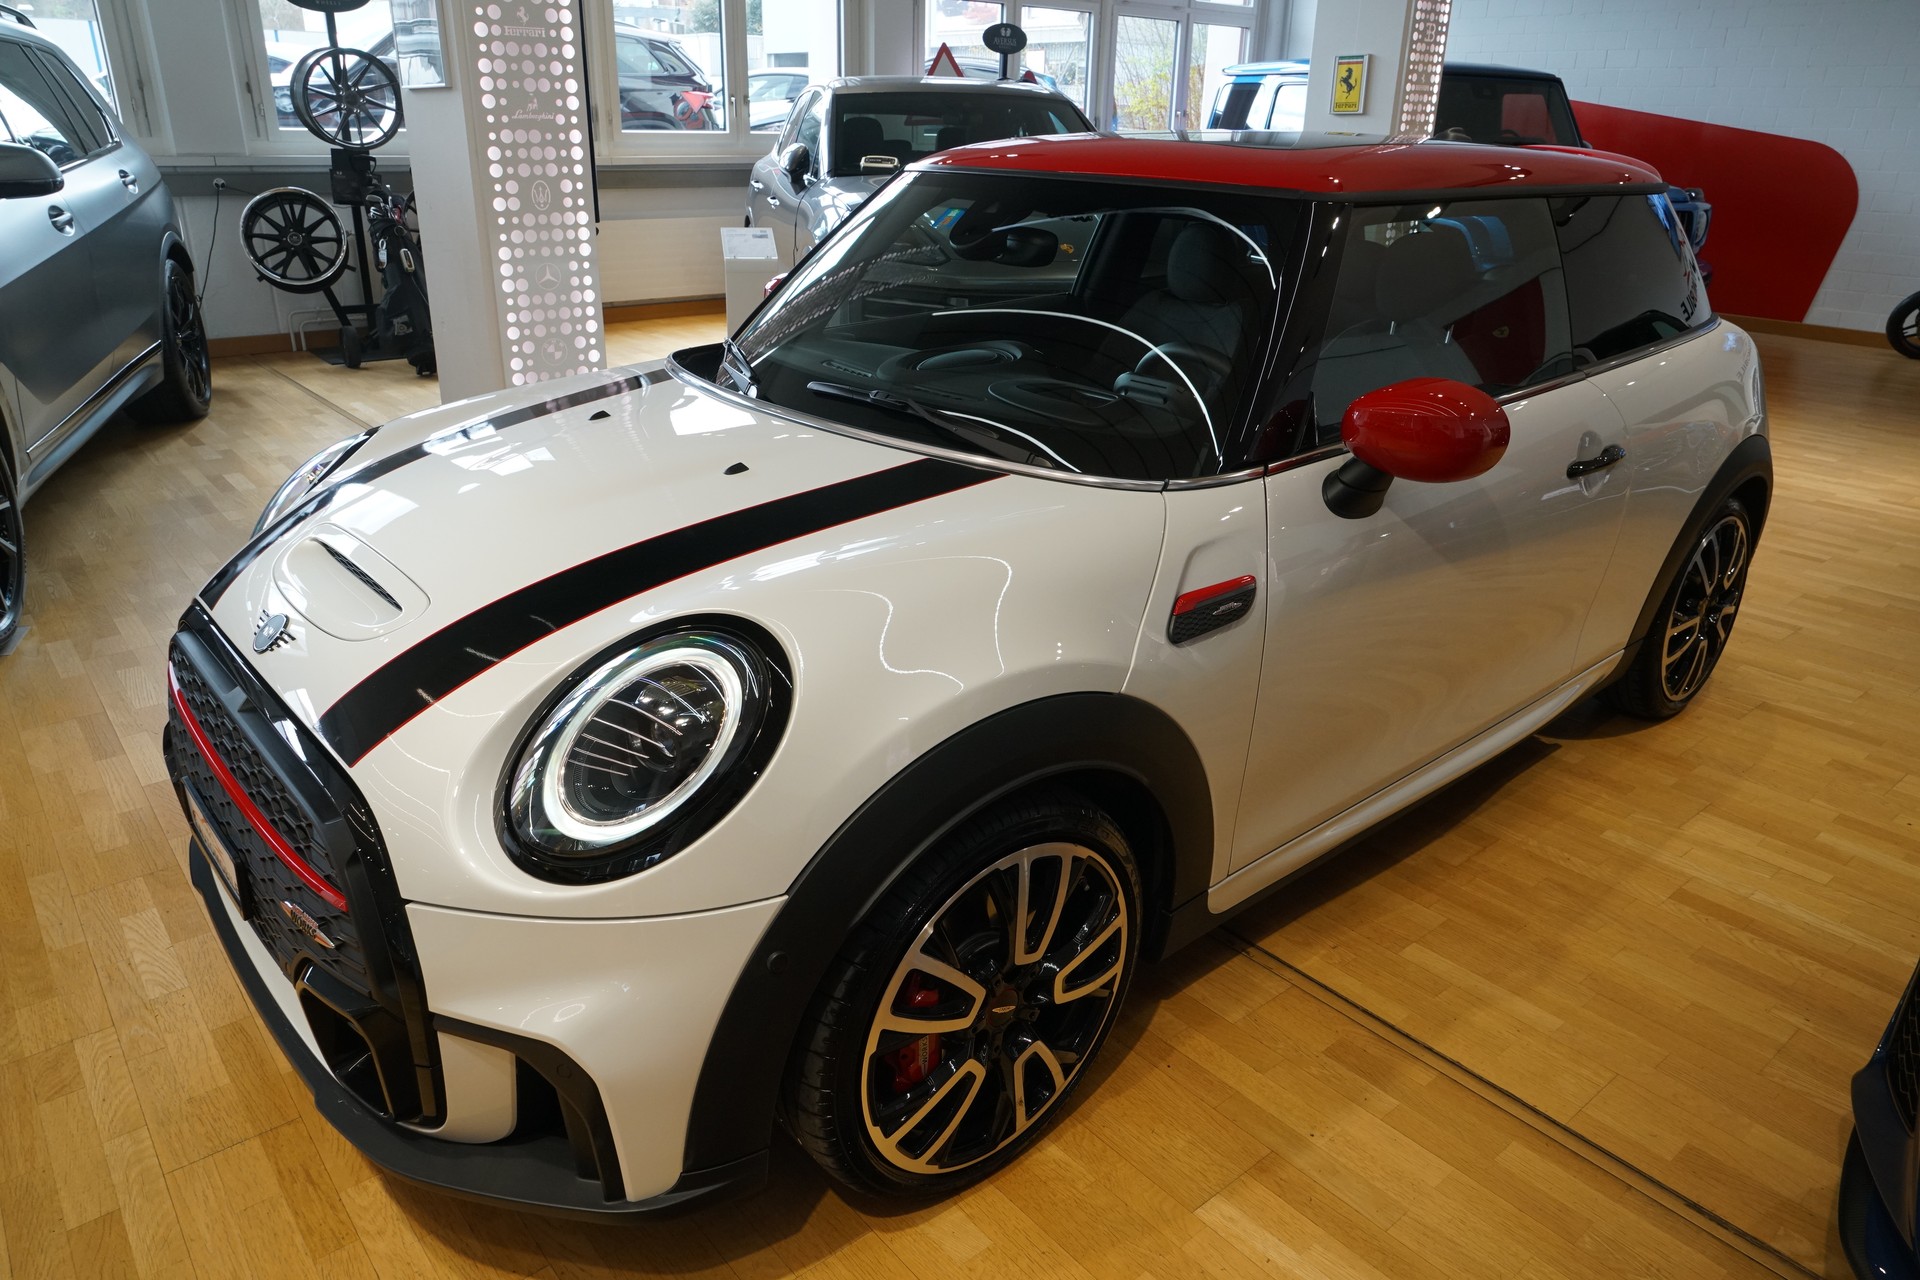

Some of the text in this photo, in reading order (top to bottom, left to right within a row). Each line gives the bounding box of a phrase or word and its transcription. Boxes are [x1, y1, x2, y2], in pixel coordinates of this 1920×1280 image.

[503, 25, 546, 38] Ferrari
[1335, 101, 1357, 109] Ferrari
[511, 109, 554, 121] Lamborghini
[290, 909, 317, 936] WORKS
